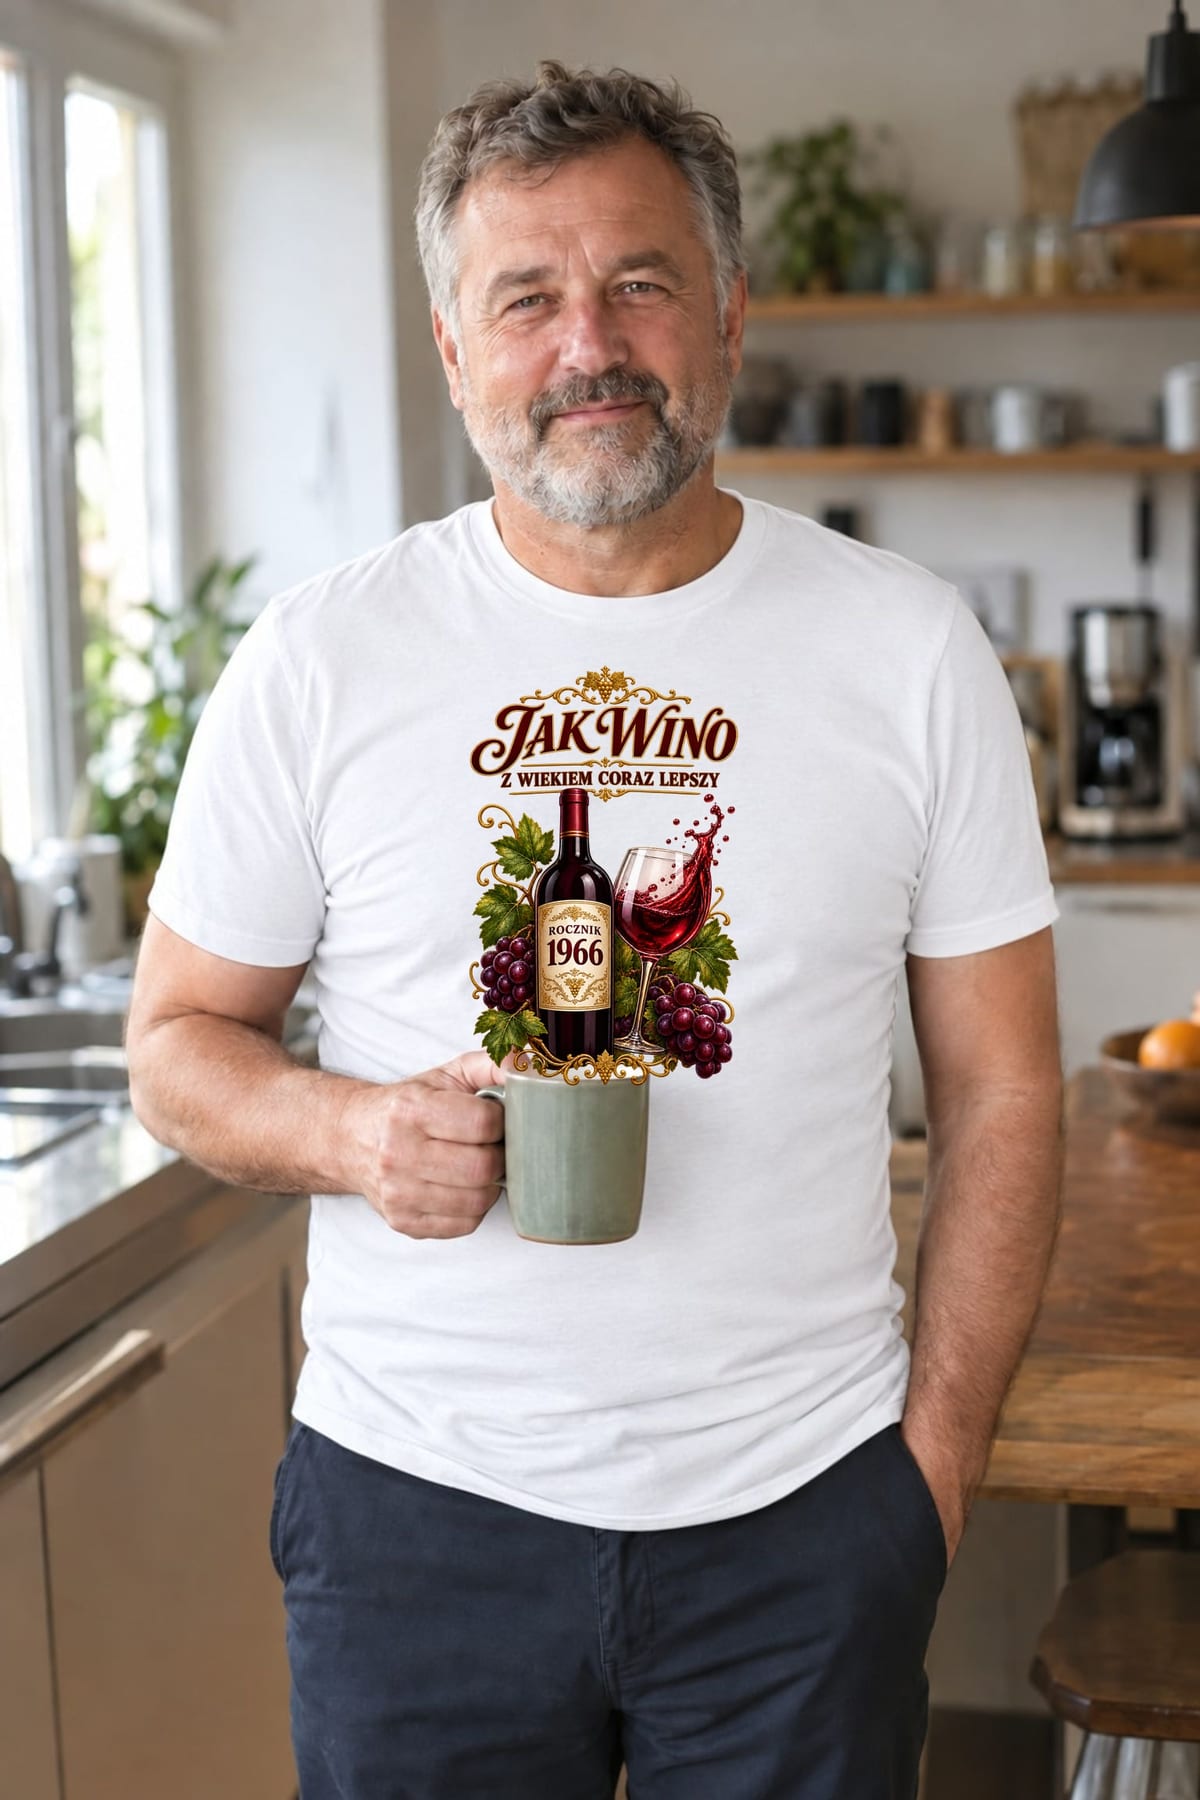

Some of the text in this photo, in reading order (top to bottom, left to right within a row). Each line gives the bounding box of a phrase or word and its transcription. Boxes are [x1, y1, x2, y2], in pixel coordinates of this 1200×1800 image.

[470, 702, 739, 777] JAK WINO
[500, 771, 720, 788] Z WIEKIEM CORAZ LEPSZY
[548, 924, 602, 936] ROCZNIK
[547, 938, 604, 966] 1966
